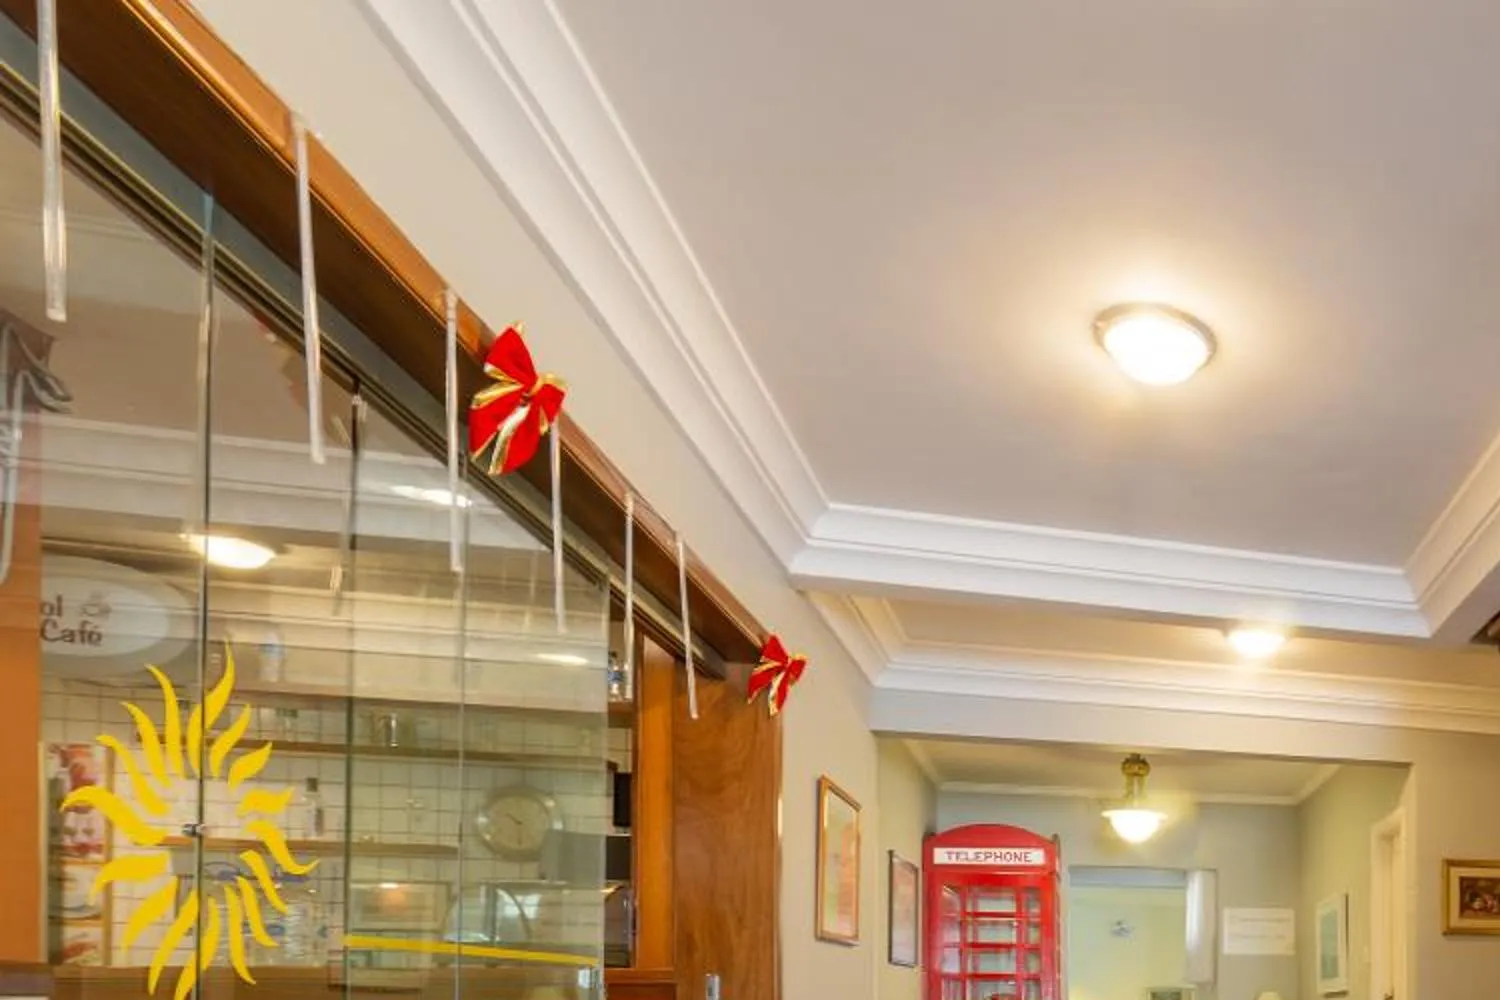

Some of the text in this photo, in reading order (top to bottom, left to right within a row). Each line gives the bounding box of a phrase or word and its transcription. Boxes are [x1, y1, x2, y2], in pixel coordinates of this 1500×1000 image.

[40, 594, 63, 617] ol
[40, 619, 103, 645] Café
[944, 851, 1032, 863] TELEPHONE
